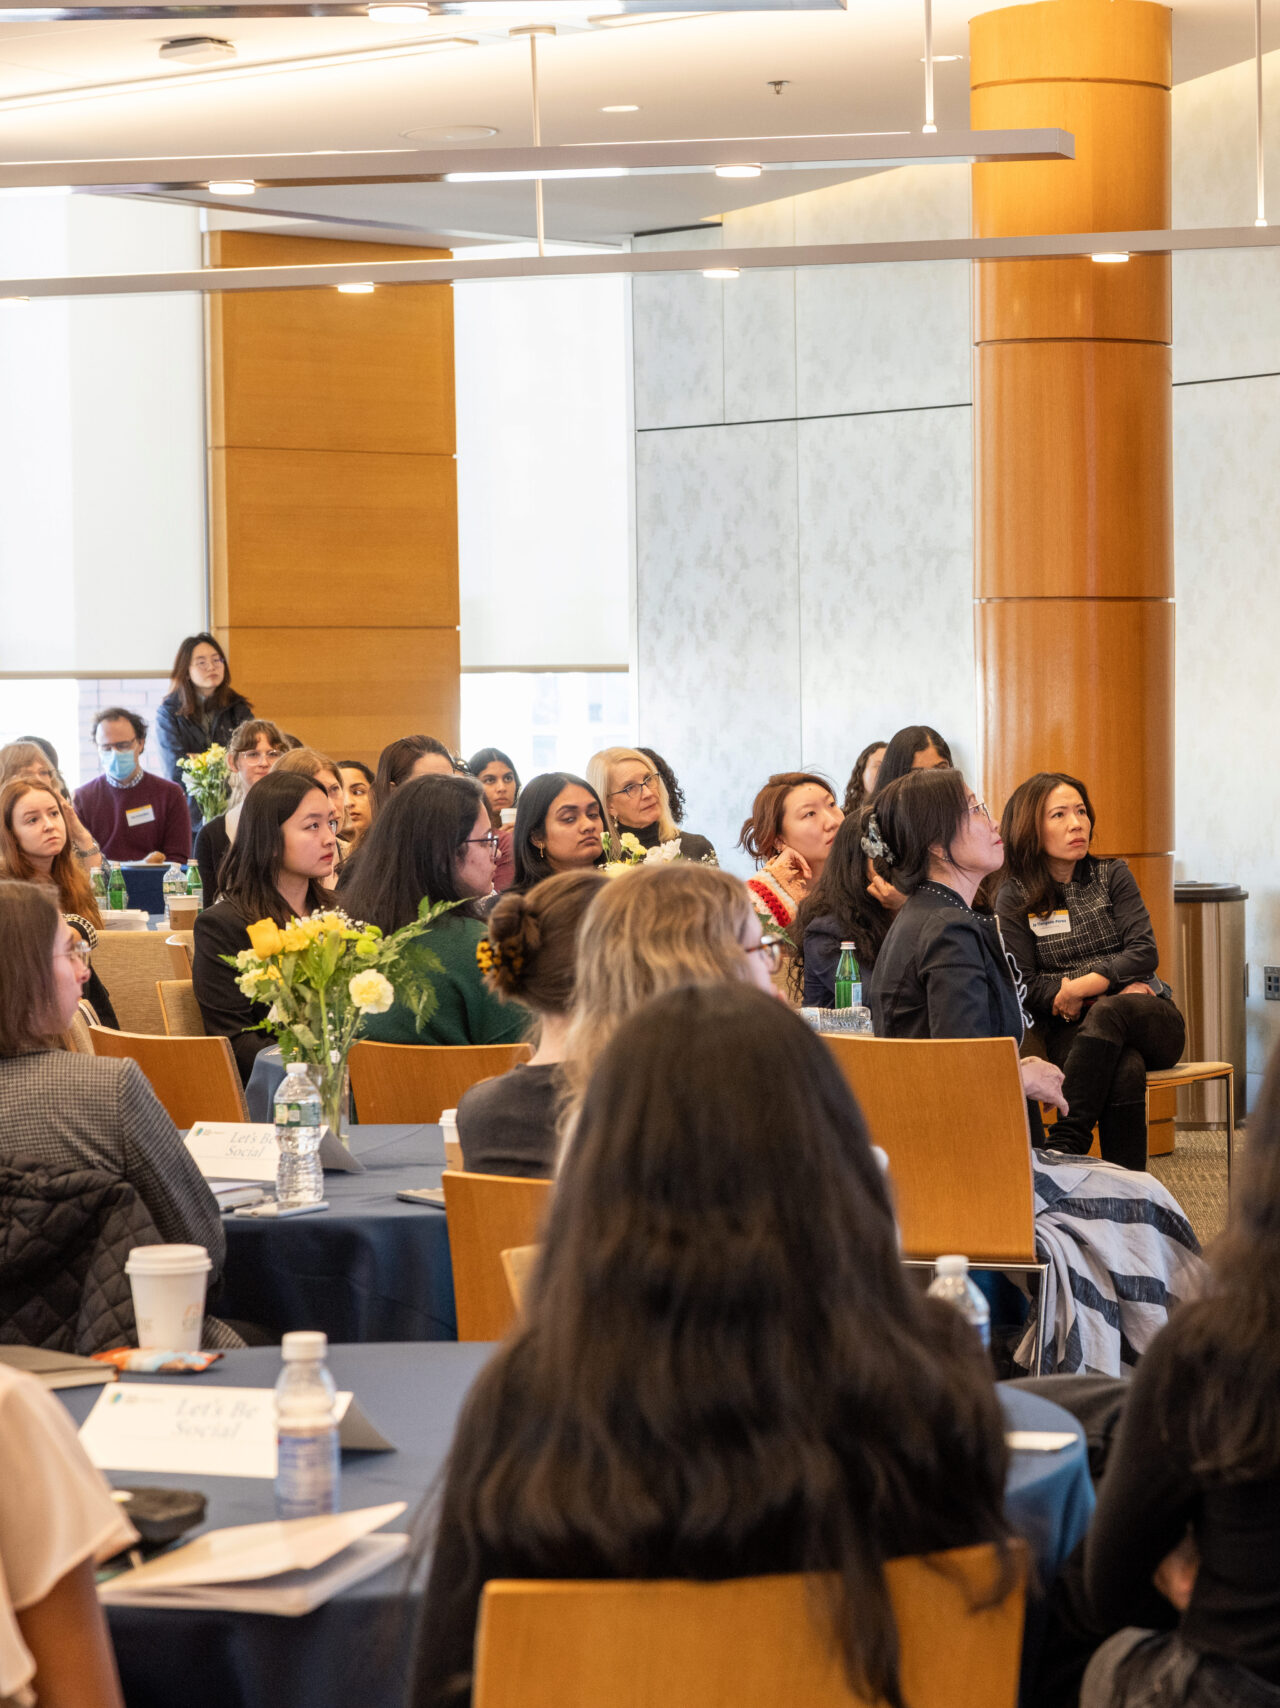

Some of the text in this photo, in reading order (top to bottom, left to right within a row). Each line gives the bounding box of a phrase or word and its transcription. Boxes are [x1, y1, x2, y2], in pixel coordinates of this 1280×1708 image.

[230, 1131, 257, 1144] Let's
[225, 1145, 266, 1158] Social
[175, 1397, 223, 1417] Let's
[229, 1399, 259, 1419] Be
[172, 1419, 242, 1440] Social
